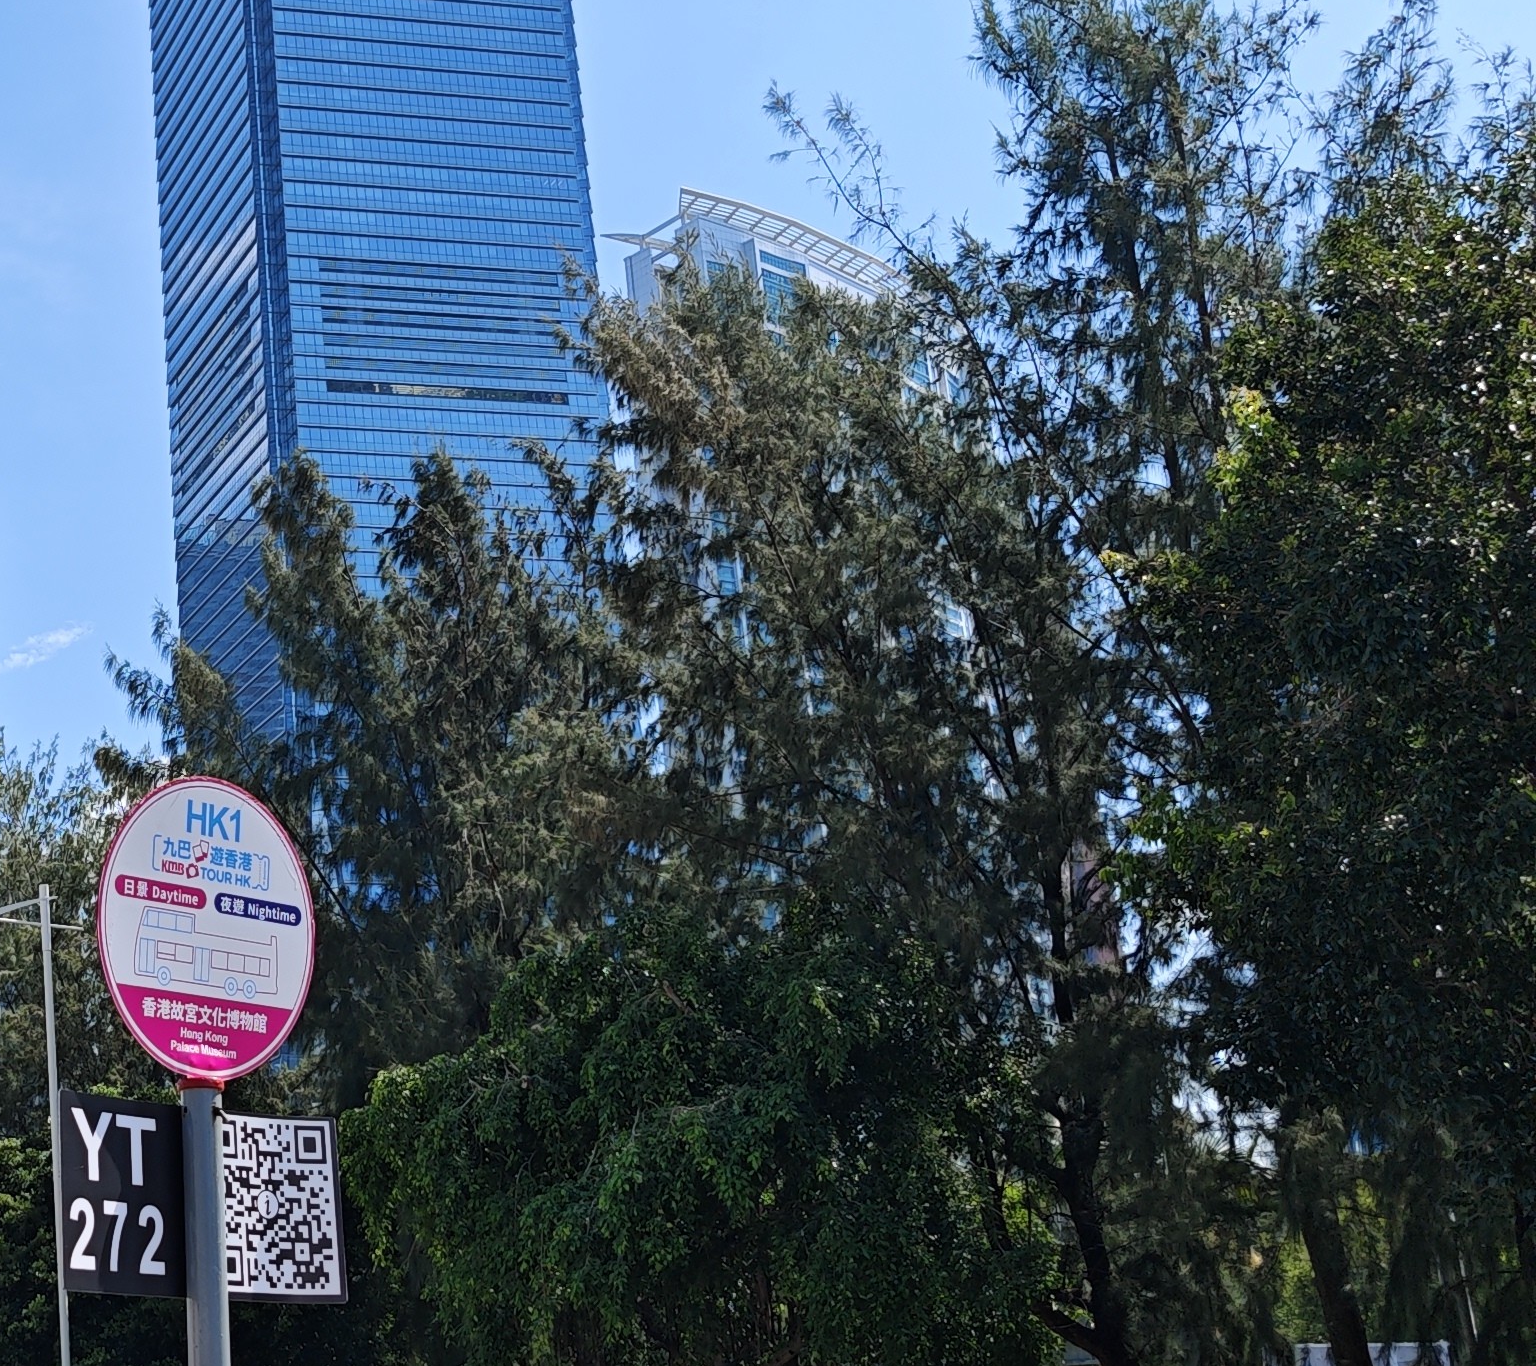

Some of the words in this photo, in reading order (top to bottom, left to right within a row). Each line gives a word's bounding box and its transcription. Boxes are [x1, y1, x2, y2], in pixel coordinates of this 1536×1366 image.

[186, 799, 241, 843] HK1
[163, 837, 191, 859] 九巴
[210, 846, 252, 872] 遊香港
[161, 859, 184, 875] KMB
[200, 867, 232, 884] TOUR
[235, 874, 251, 888] HK
[124, 879, 148, 898] 日景
[152, 886, 199, 905] Daytime
[220, 896, 244, 915] 夜遊
[142, 996, 267, 1034] 香港故宮文化博物館
[170, 1040, 199, 1054] Palace
[201, 1044, 237, 1059] Museum
[180, 1027, 203, 1042] Hong
[205, 1030, 228, 1045] Kong
[70, 1106, 157, 1186] YT
[69, 1197, 166, 1276] 272
